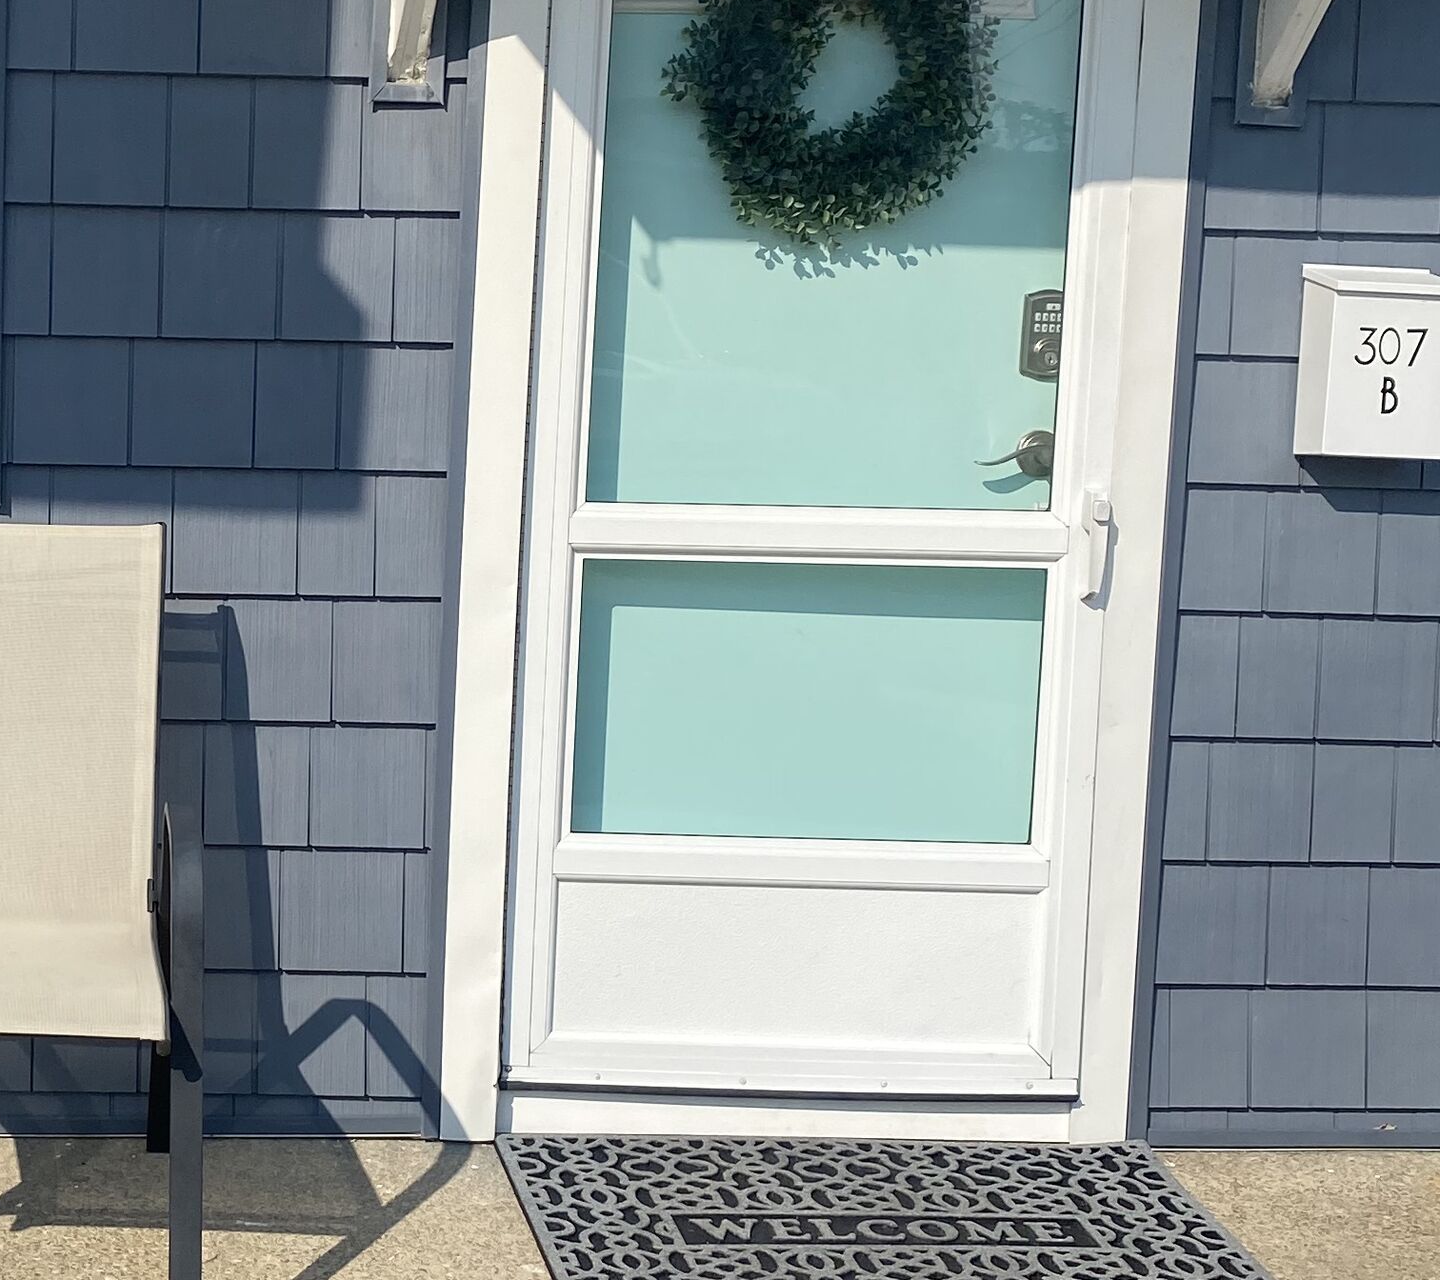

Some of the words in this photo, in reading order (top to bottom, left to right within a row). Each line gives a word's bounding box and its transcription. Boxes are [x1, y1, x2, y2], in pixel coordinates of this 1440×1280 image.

[1354, 327, 1429, 367] 307
[1380, 376, 1399, 414] B
[689, 1218, 1075, 1243] WELCOME
